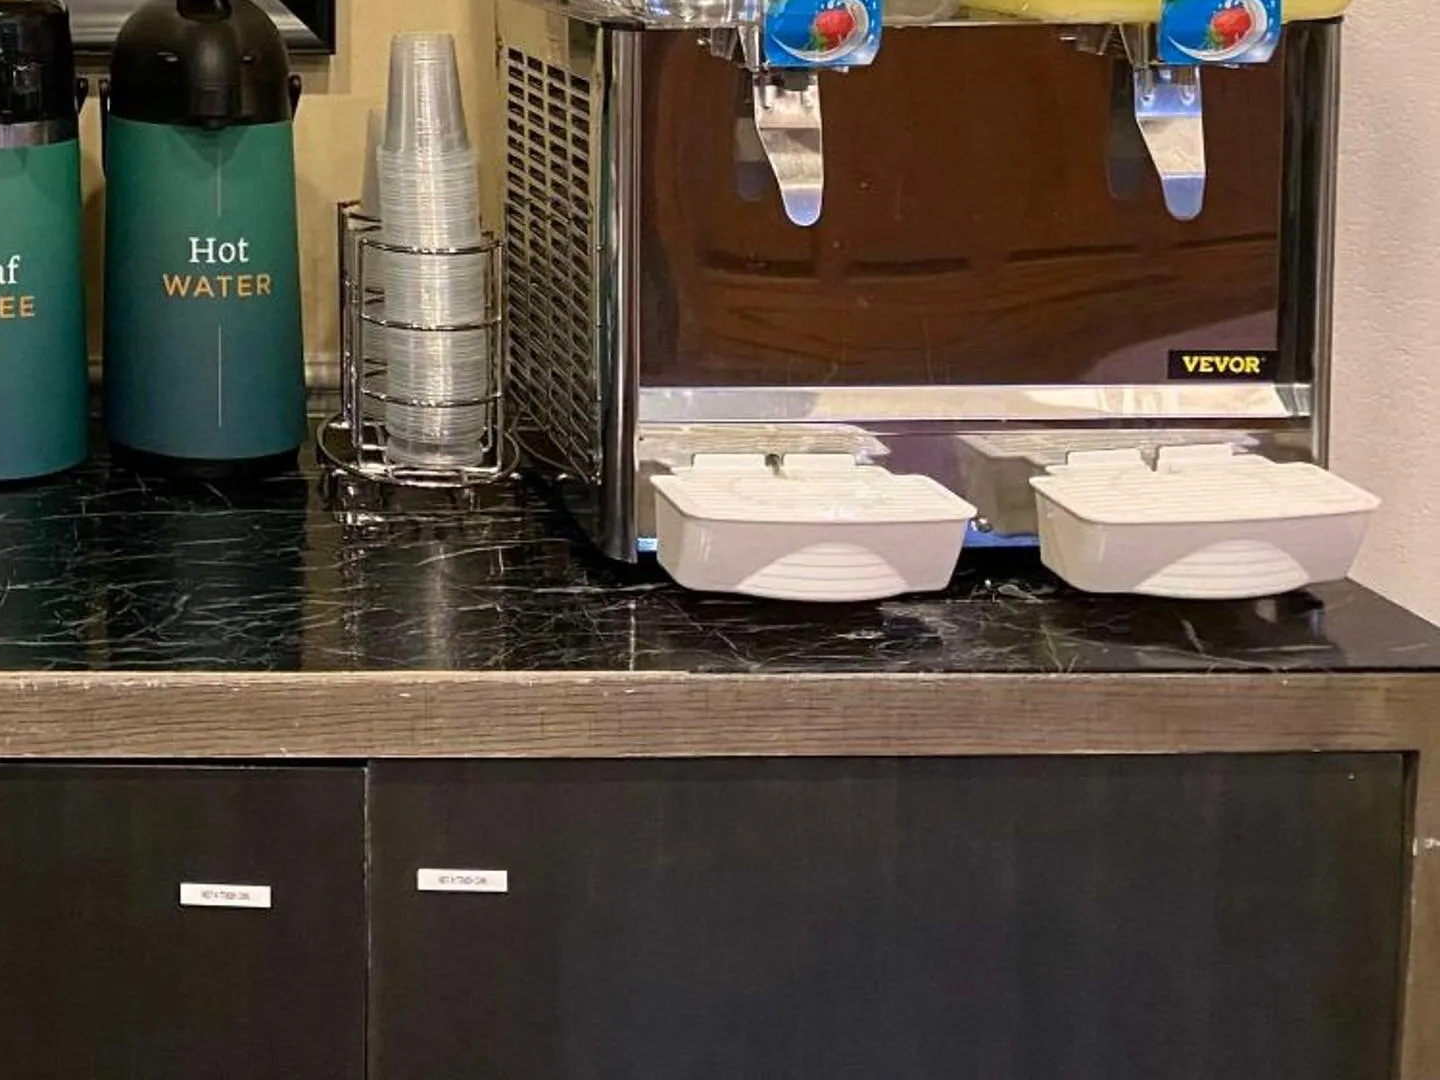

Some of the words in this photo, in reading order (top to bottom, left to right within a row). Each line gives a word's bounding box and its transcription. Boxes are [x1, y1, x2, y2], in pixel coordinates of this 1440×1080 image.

[188, 236, 250, 263] Hot
[162, 272, 272, 298] WATER
[1182, 355, 1260, 374] VEVOR
